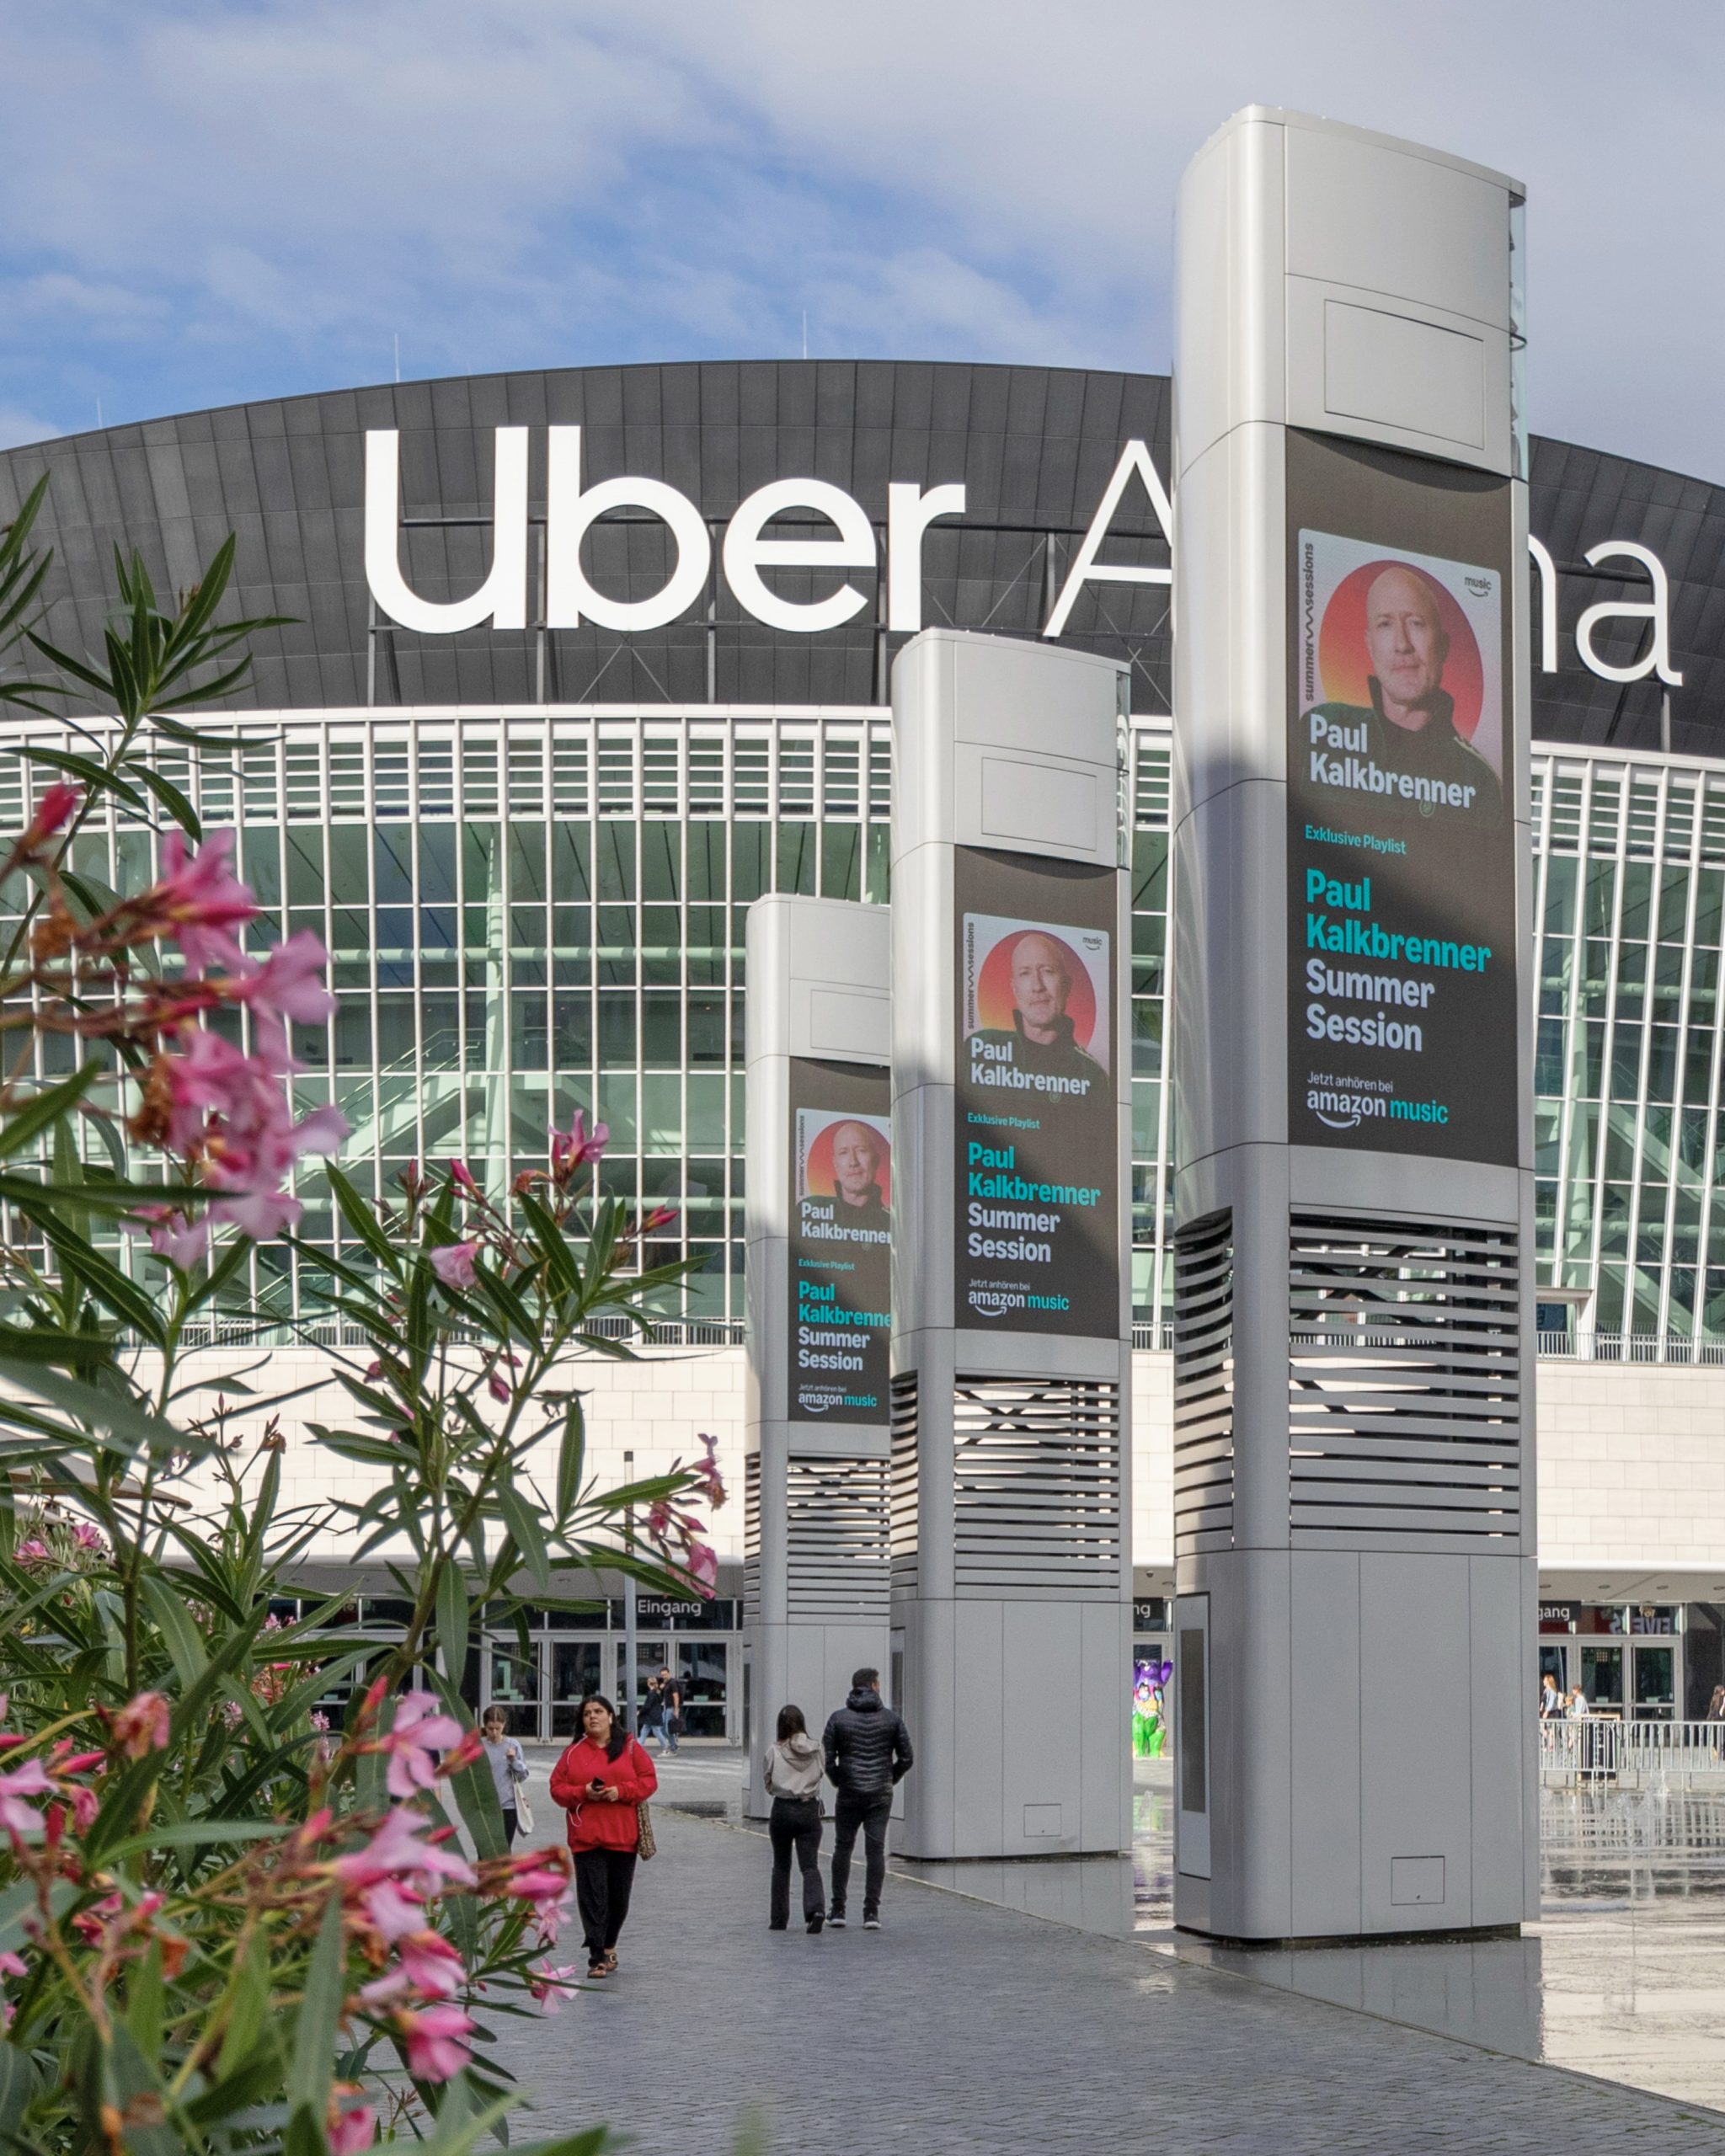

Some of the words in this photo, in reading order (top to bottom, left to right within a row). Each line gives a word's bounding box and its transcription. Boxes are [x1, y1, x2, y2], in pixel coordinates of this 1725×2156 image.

[365, 425, 966, 633] Uber
[1303, 543, 1314, 606] sessions
[1464, 576, 1492, 590] music
[1306, 641, 1314, 701] summer
[1310, 713, 1368, 754] Paul
[1310, 751, 1476, 808] Kalkbrenner
[1305, 824, 1361, 848] Exklusive
[1363, 835, 1407, 855] Playlist
[1306, 868, 1370, 911] Paul
[1306, 913, 1492, 973] Kalkbrenner
[1306, 958, 1435, 1009] Summer
[1306, 1002, 1423, 1053] Session
[971, 1037, 1012, 1063] Paul
[971, 1063, 1091, 1096] Kalkbrenner
[1307, 1071, 1334, 1086] Jetzt
[1335, 1076, 1377, 1091] anhören
[1378, 1080, 1394, 1093] bei
[968, 1113, 1008, 1127] Exklusive
[1009, 1117, 1041, 1130] Playlist
[1306, 1090, 1386, 1118] amazon
[1390, 1100, 1449, 1124] music
[968, 1142, 1015, 1170] Paul
[968, 1172, 1101, 1207] Kalkbrenner
[802, 1202, 834, 1220] Paul
[968, 1202, 1060, 1233] Summer
[968, 1232, 1052, 1262] Session
[798, 1281, 836, 1301] Paul
[968, 1289, 1025, 1308] amazon
[1028, 1294, 1070, 1310] music
[969, 1278, 988, 1289] Jetzt
[1019, 1281, 1031, 1291] bei
[798, 1304, 891, 1328] Kalkbrenne
[798, 1326, 871, 1348] Summer
[798, 1349, 863, 1371] Session
[798, 1392, 842, 1406] amazon
[844, 1394, 877, 1407] music
[638, 1599, 702, 1617] Eingang
